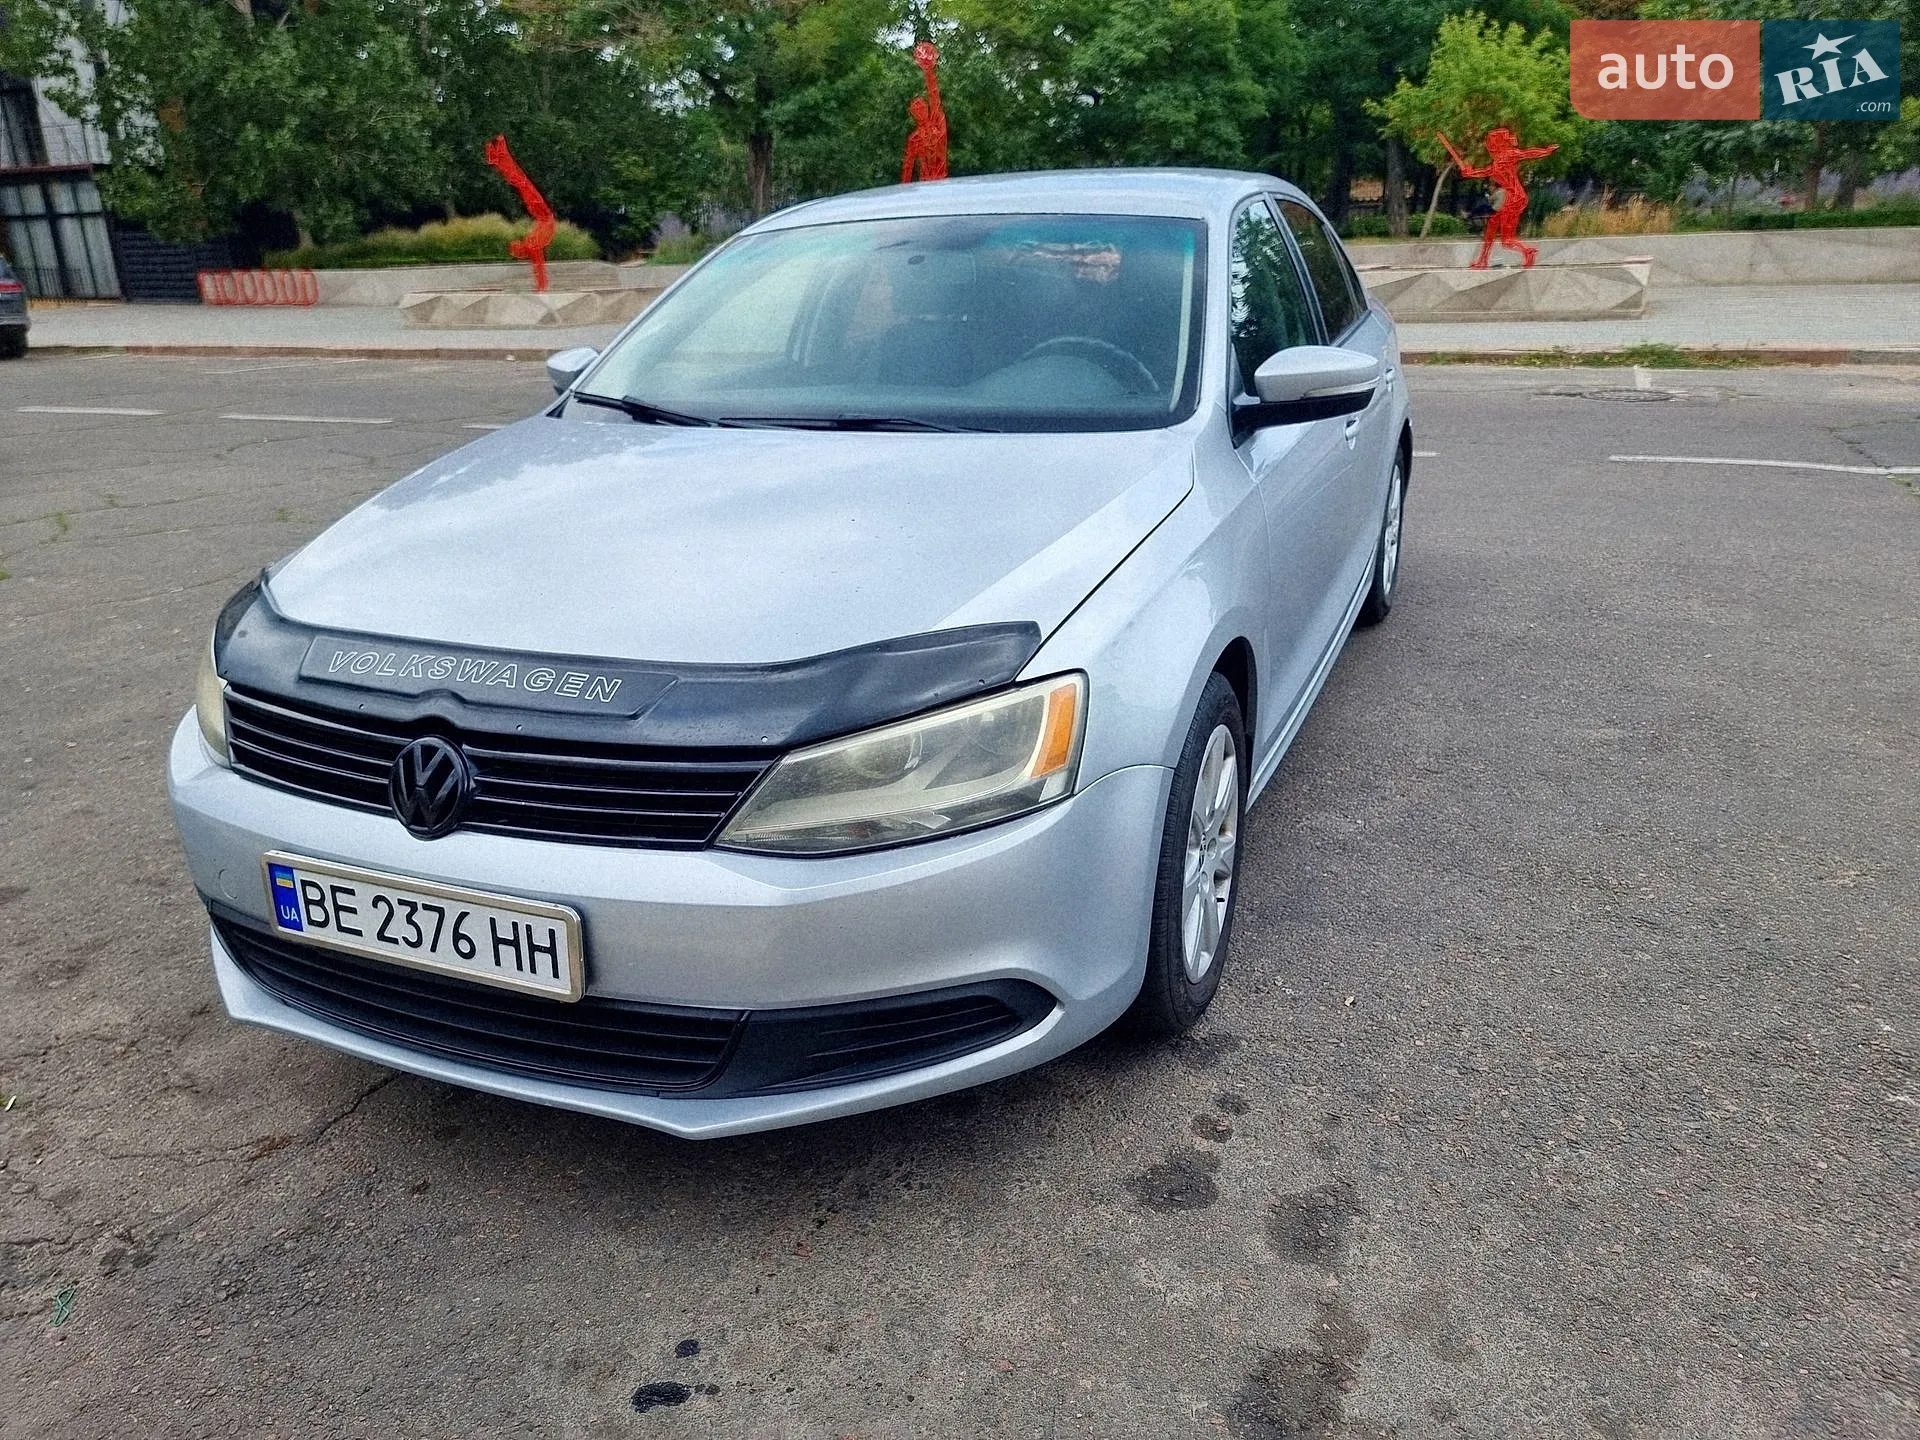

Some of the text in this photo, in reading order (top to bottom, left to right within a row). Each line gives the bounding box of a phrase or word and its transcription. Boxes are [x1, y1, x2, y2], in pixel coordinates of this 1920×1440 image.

[328, 650, 622, 703] VOLKSWAGEN
[280, 904, 300, 923] UA
[300, 879, 560, 979] BE 2376 HH
